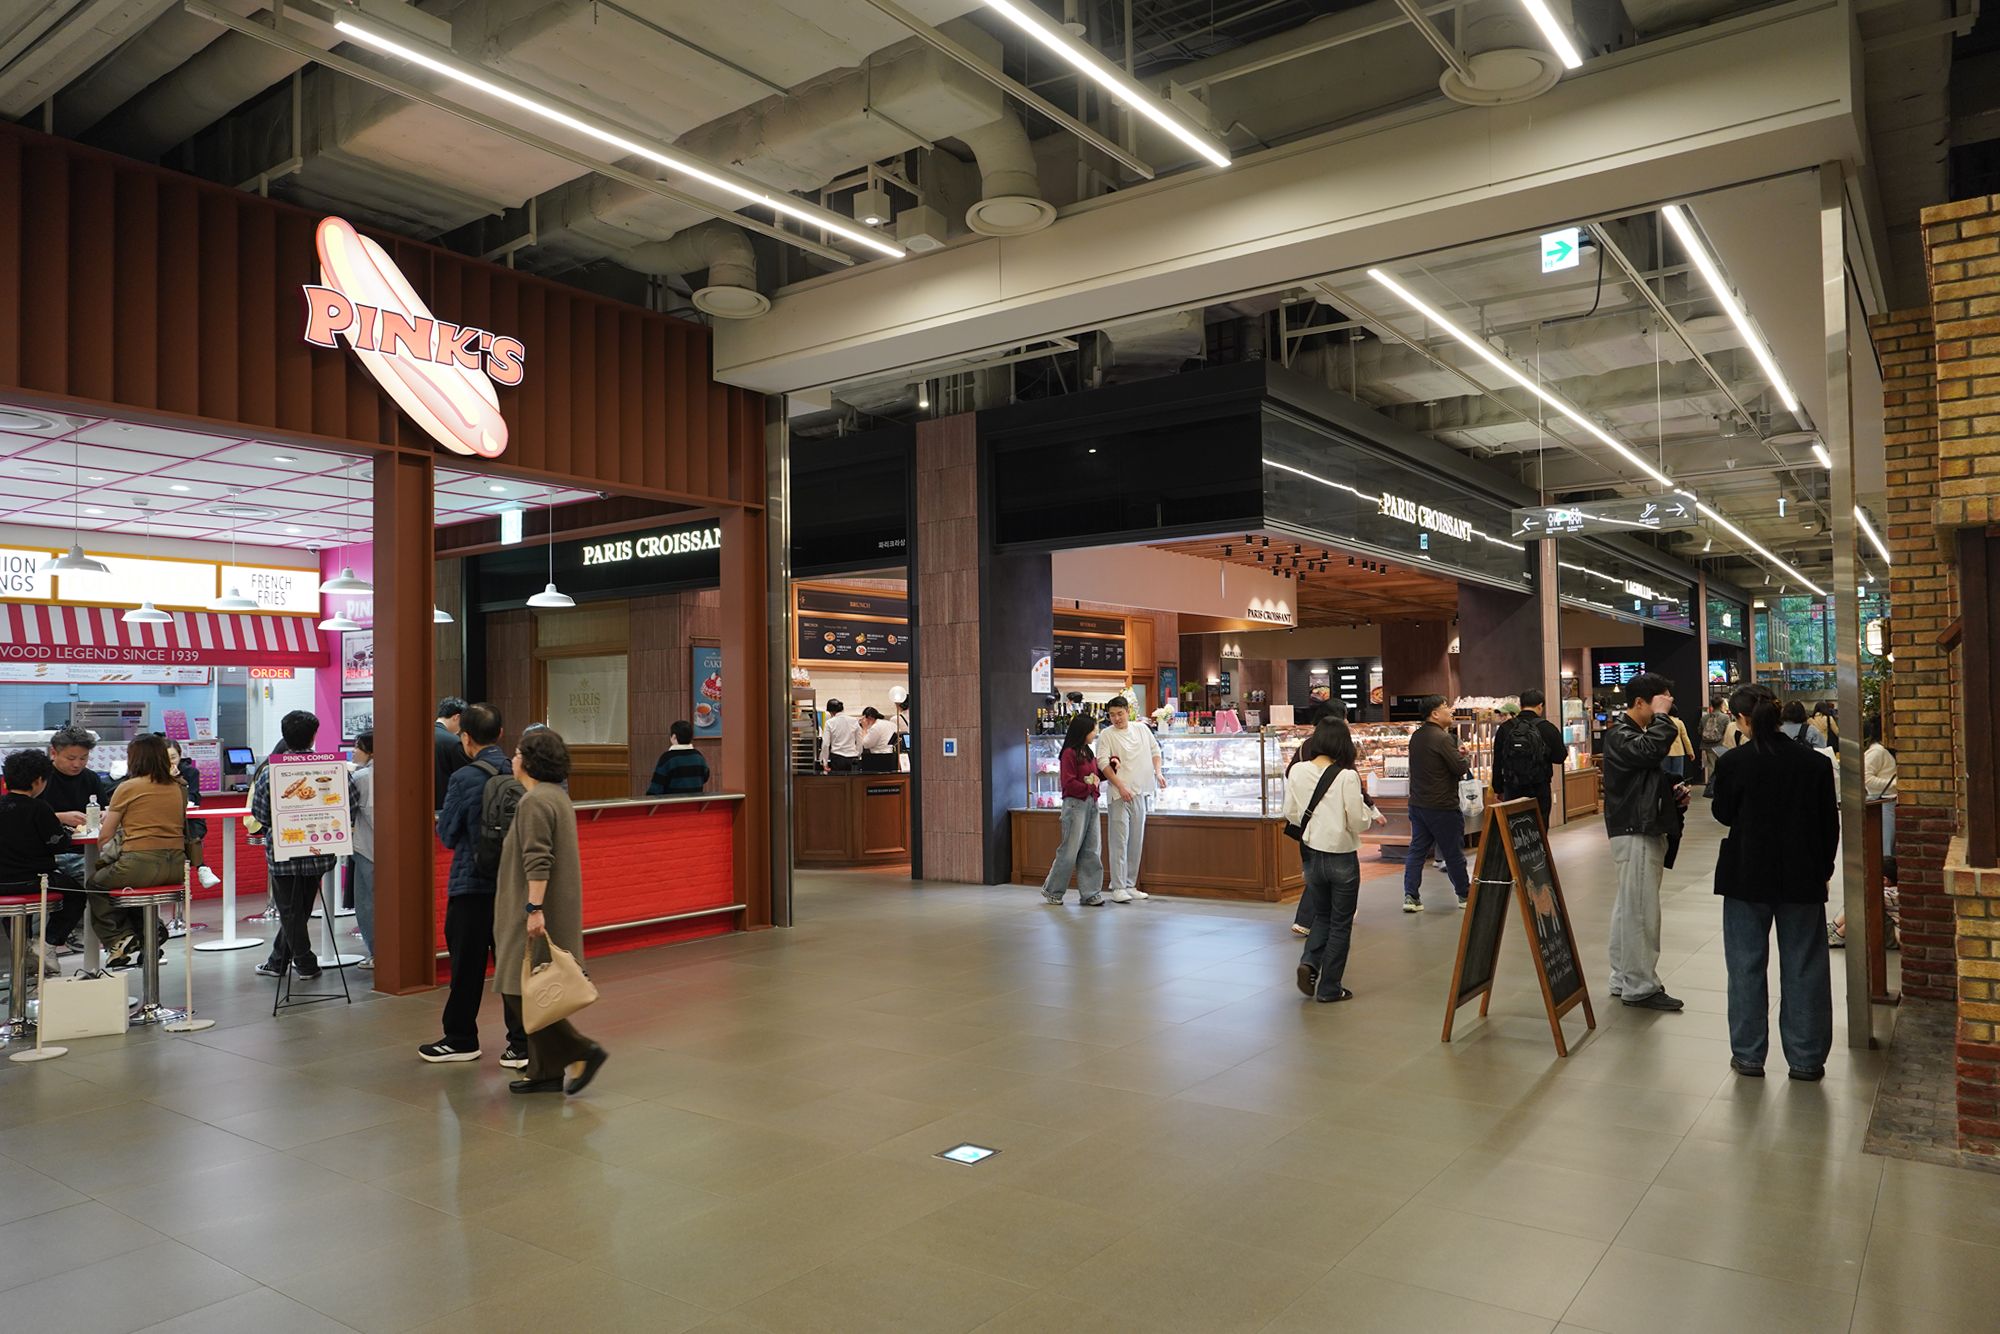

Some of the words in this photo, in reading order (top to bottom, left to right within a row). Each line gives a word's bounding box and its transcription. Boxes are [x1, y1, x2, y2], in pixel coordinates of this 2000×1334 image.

[303, 285, 525, 386] PINK'S
[1383, 492, 1416, 524] PARIS
[1418, 505, 1472, 542] CROISSANT
[583, 540, 632, 566] PARIS
[251, 574, 292, 590] FRENCH
[257, 590, 287, 606] FRIES
[1247, 608, 1263, 620] PARIS
[1263, 610, 1291, 623] CROISSANT
[56, 647, 119, 660] LEGEND
[122, 648, 165, 661] SINCE
[171, 650, 200, 662] 1939
[250, 668, 291, 678] ORDER
[568, 692, 601, 706] PARIS
